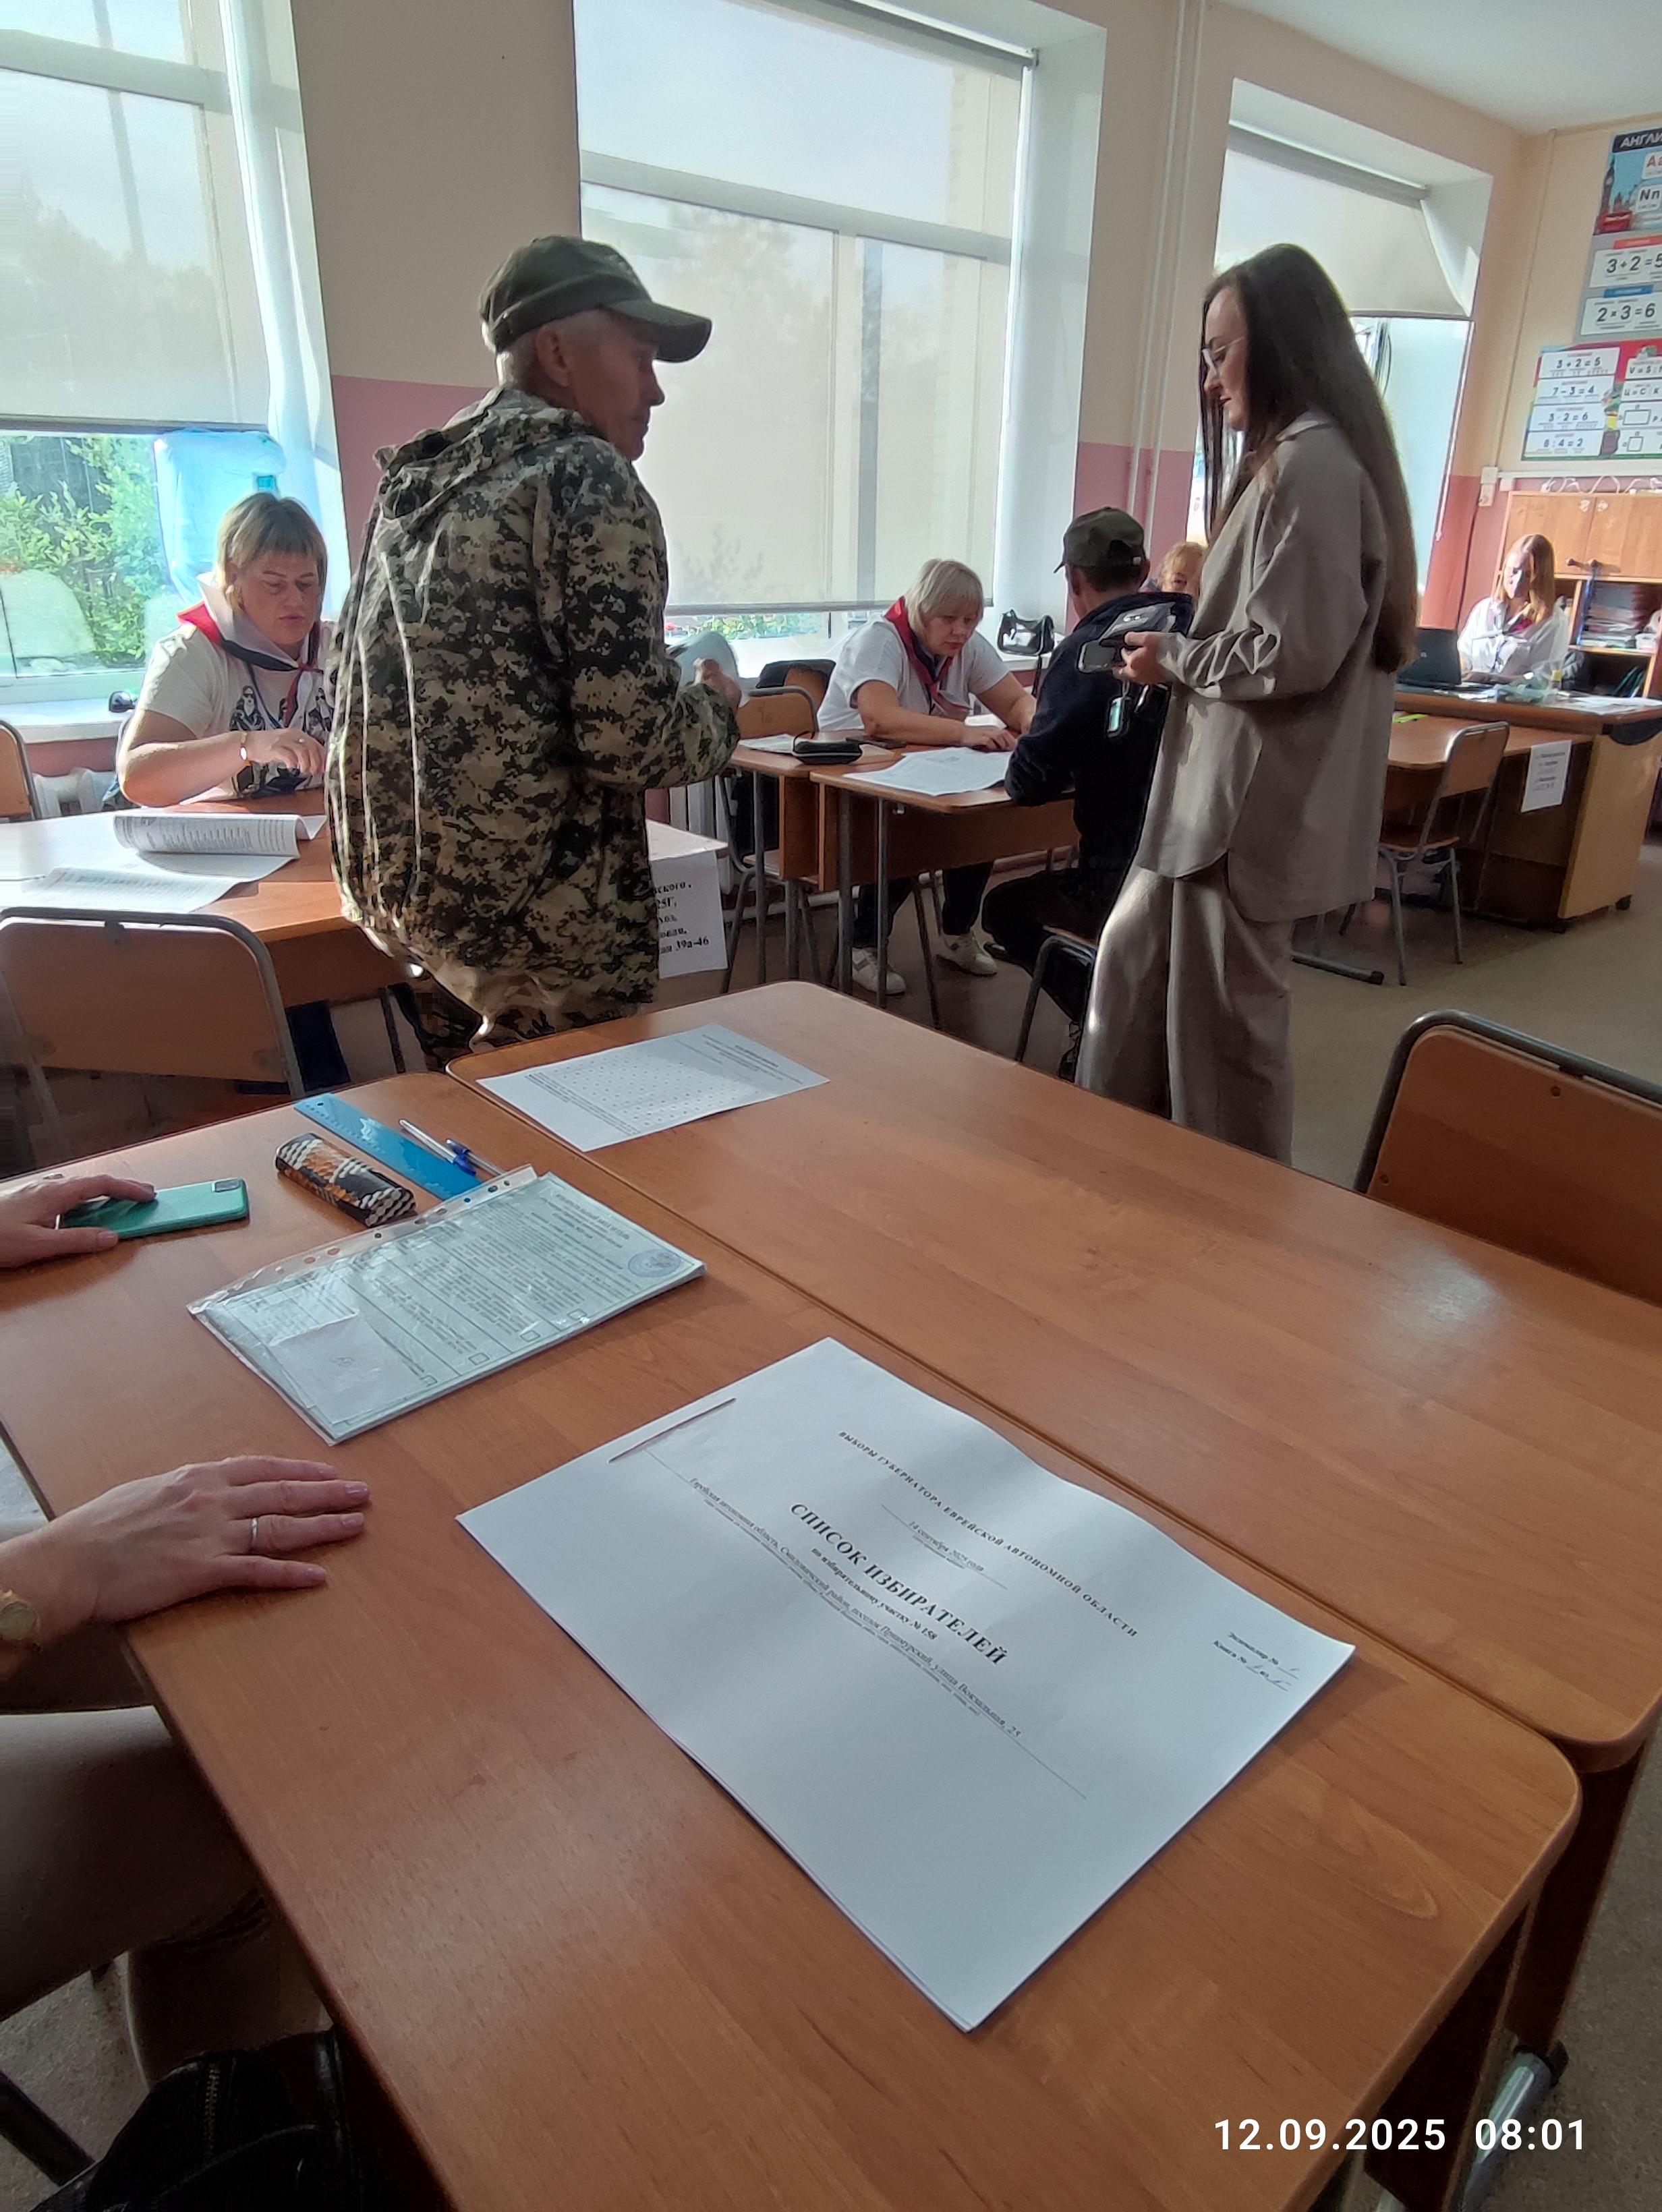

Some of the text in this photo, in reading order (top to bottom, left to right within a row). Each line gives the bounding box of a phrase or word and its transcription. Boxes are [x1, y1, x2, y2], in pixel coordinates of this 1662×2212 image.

[1640, 190, 1660, 201] Nn
[791, 1505, 866, 1565] СПИСОК
[865, 1565, 1007, 1664] ИЗБИРАТЕЛЕЙ
[839, 1432, 878, 1457] ВЫБОРЫ
[878, 1457, 941, 1507] ГУБЕРНАТОРА
[944, 1507, 1004, 1545] ЕВРЕЙСКОЙ
[1007, 1546, 1081, 1593] АВТОНОМНОЙ
[1083, 1594, 1137, 1636] ОБЛАСТИ
